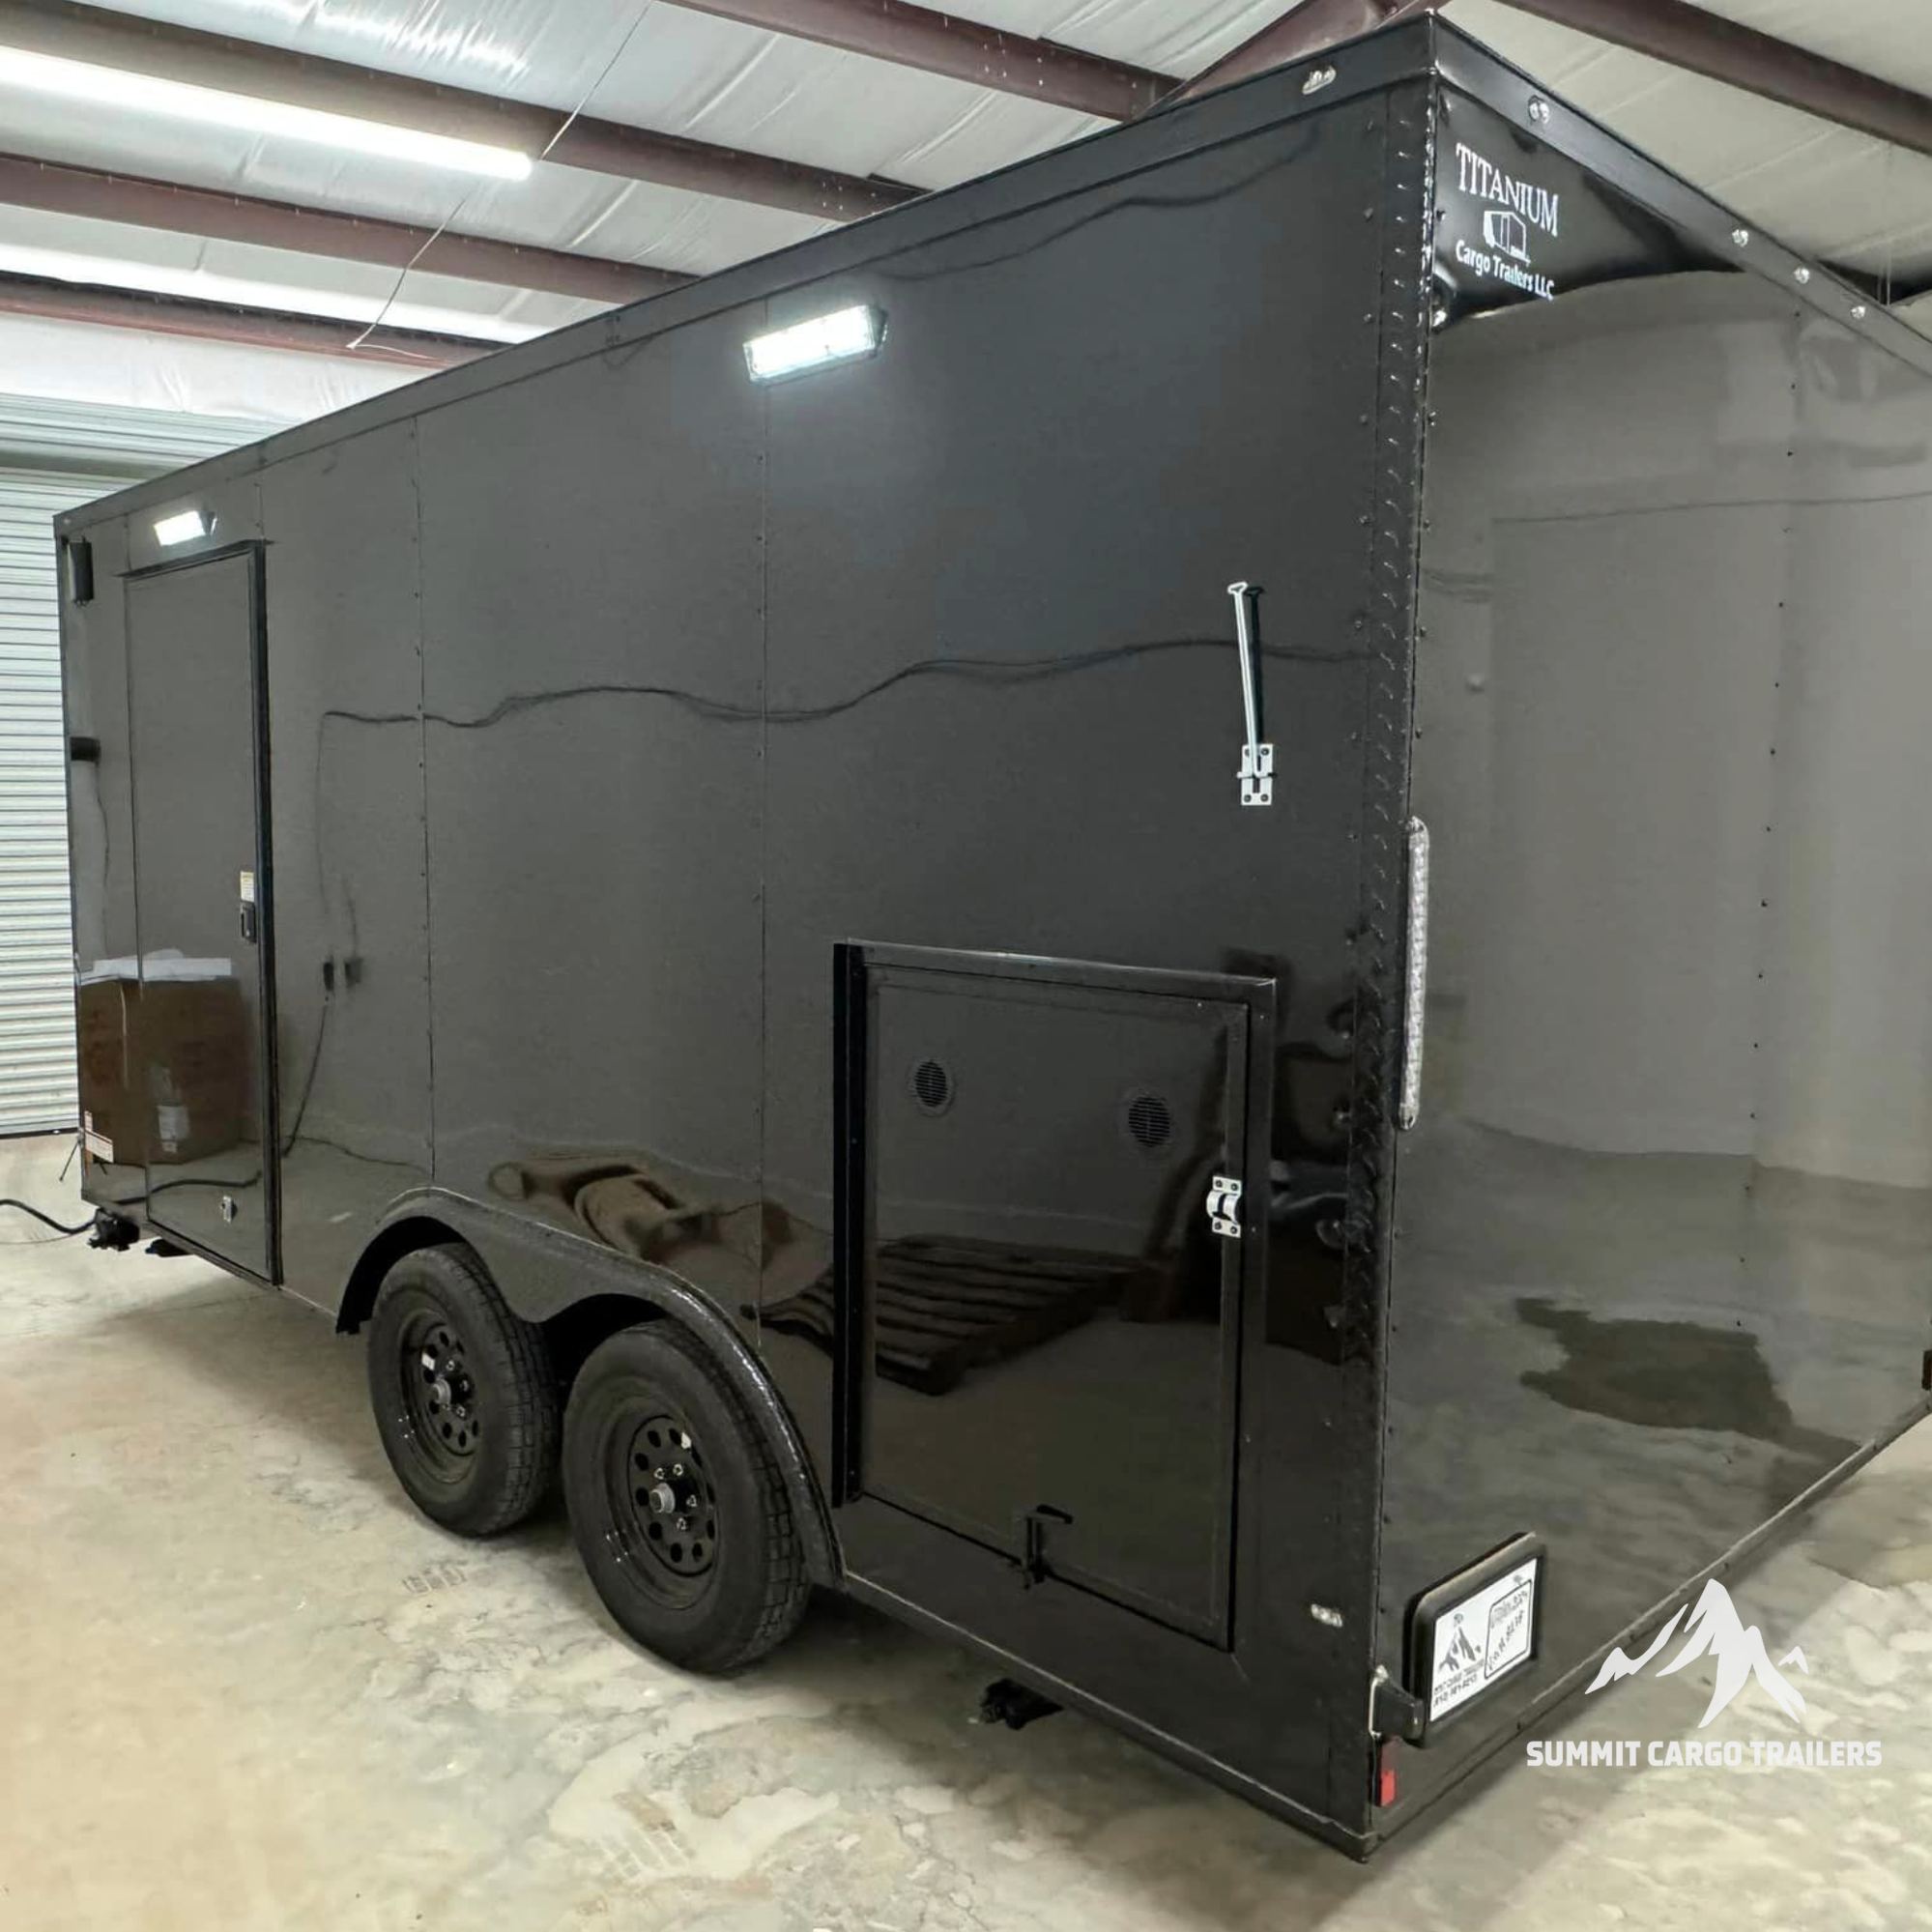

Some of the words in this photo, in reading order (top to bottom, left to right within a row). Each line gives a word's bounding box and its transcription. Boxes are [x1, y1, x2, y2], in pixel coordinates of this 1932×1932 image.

[1456, 142, 1558, 237] TITANIUM
[1456, 239, 1490, 276] Cargo
[1493, 255, 1533, 292] Trailers
[1535, 274, 1554, 302] LLC
